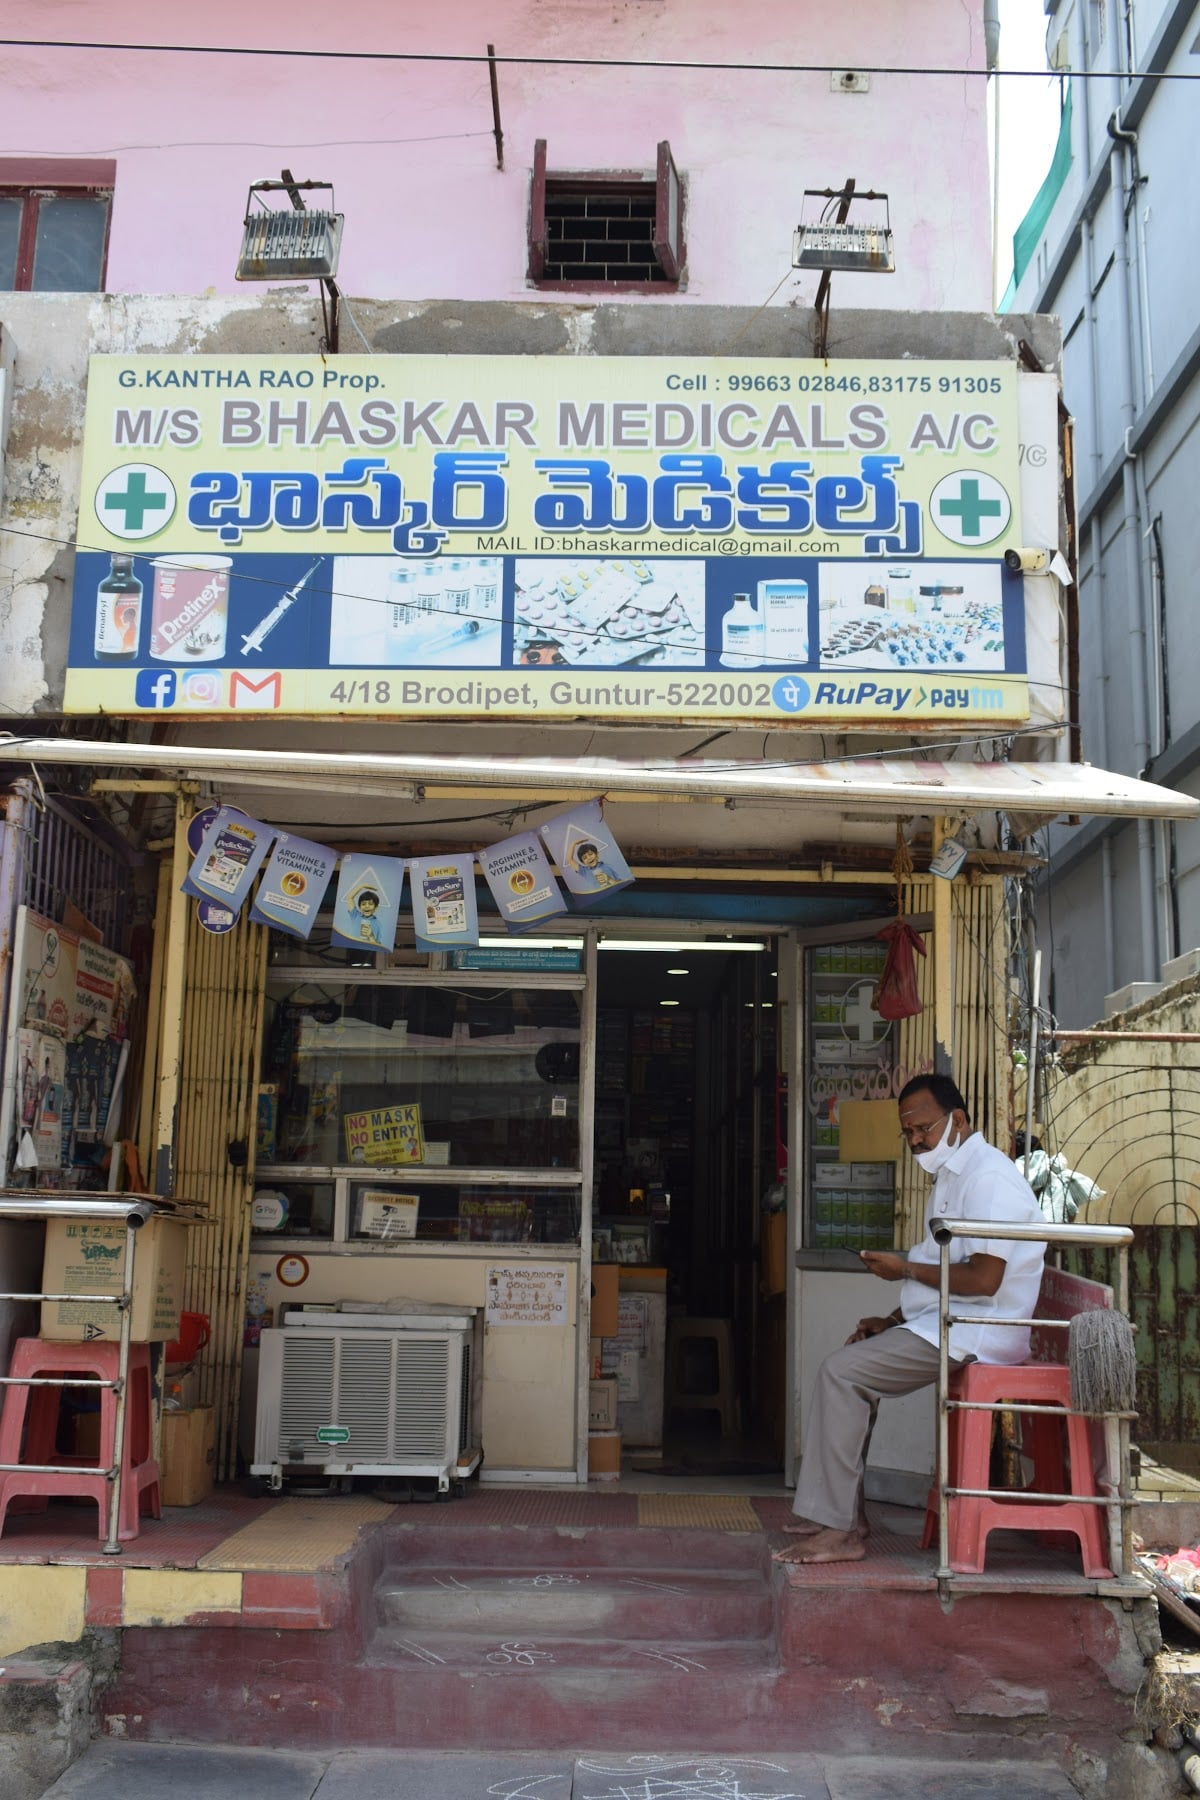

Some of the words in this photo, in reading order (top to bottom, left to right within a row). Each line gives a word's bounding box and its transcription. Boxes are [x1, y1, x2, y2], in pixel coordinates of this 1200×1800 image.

[118, 370, 251, 388] G.KANTHA
[259, 370, 314, 388] RAO
[323, 370, 386, 393] Prop.
[666, 374, 707, 391] Cell
[728, 375, 791, 392] 99663
[799, 376, 932, 395] 02846,83175
[938, 377, 1002, 394] 91305
[115, 409, 199, 444] M/S
[222, 400, 536, 446] BHASKAR
[557, 401, 887, 449] MEDICALS
[910, 413, 997, 451] A/C
[189, 452, 508, 555] భాస్కర్
[534, 454, 923, 557] మెడికల్స్
[476, 537, 527, 551] MAIL
[535, 537, 841, 556] ID:bhaskarmedical@gmail.com
[158, 576, 226, 645] Protinex
[330, 681, 391, 703] 4/18
[402, 681, 538, 709] Brodipet,
[550, 682, 770, 707] Guntur-522002
[814, 682, 912, 711] RuPay
[277, 855, 312, 873] VITAMIN
[313, 868, 325, 878] K2
[278, 849, 320, 867] ARGININE
[488, 849, 528, 870] ARGININE
[490, 858, 527, 877] VITAMIN
[528, 853, 539, 863] K2
[349, 1116, 367, 1130] NO
[371, 1108, 414, 1126] MASK
[350, 1131, 369, 1145] NO
[373, 1124, 416, 1143] ENTRY
